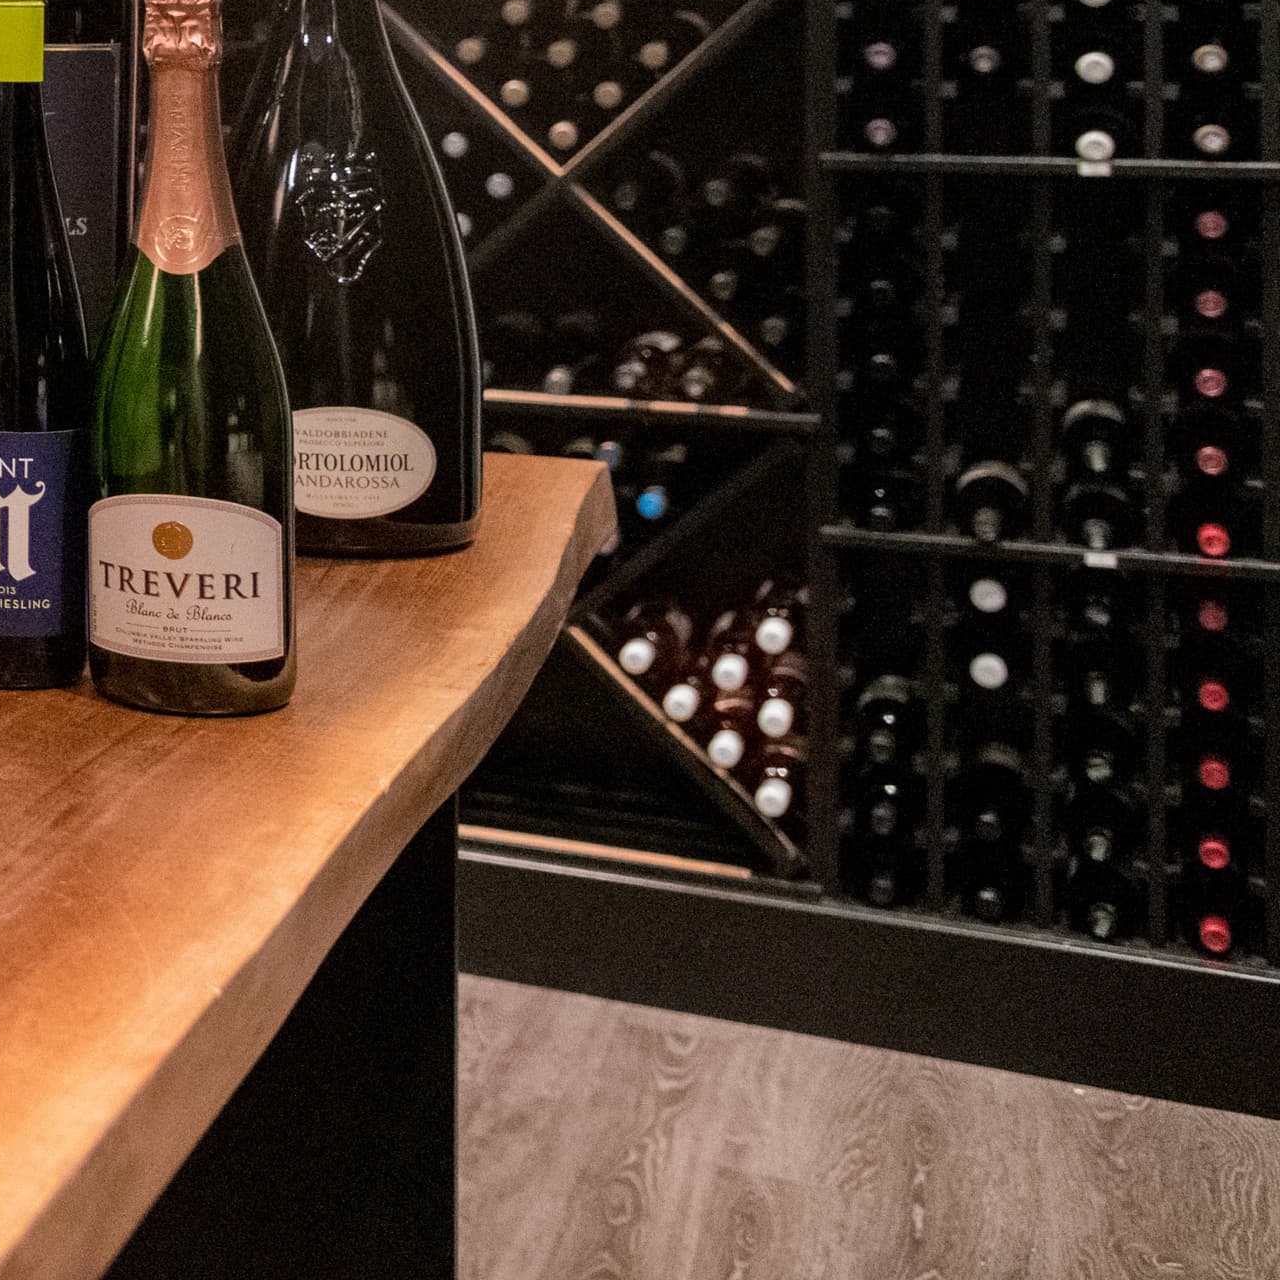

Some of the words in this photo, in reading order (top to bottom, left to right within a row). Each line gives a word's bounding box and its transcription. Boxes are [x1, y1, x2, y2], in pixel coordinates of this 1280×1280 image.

[294, 451, 415, 473] RTOLOMIOL
[295, 474, 401, 490] ANDAROSSA
[98, 559, 262, 601] TREVERI
[125, 598, 162, 619] Blanc
[166, 607, 180, 620] de
[186, 605, 233, 622] Blancs
[161, 625, 189, 634] BRUT
